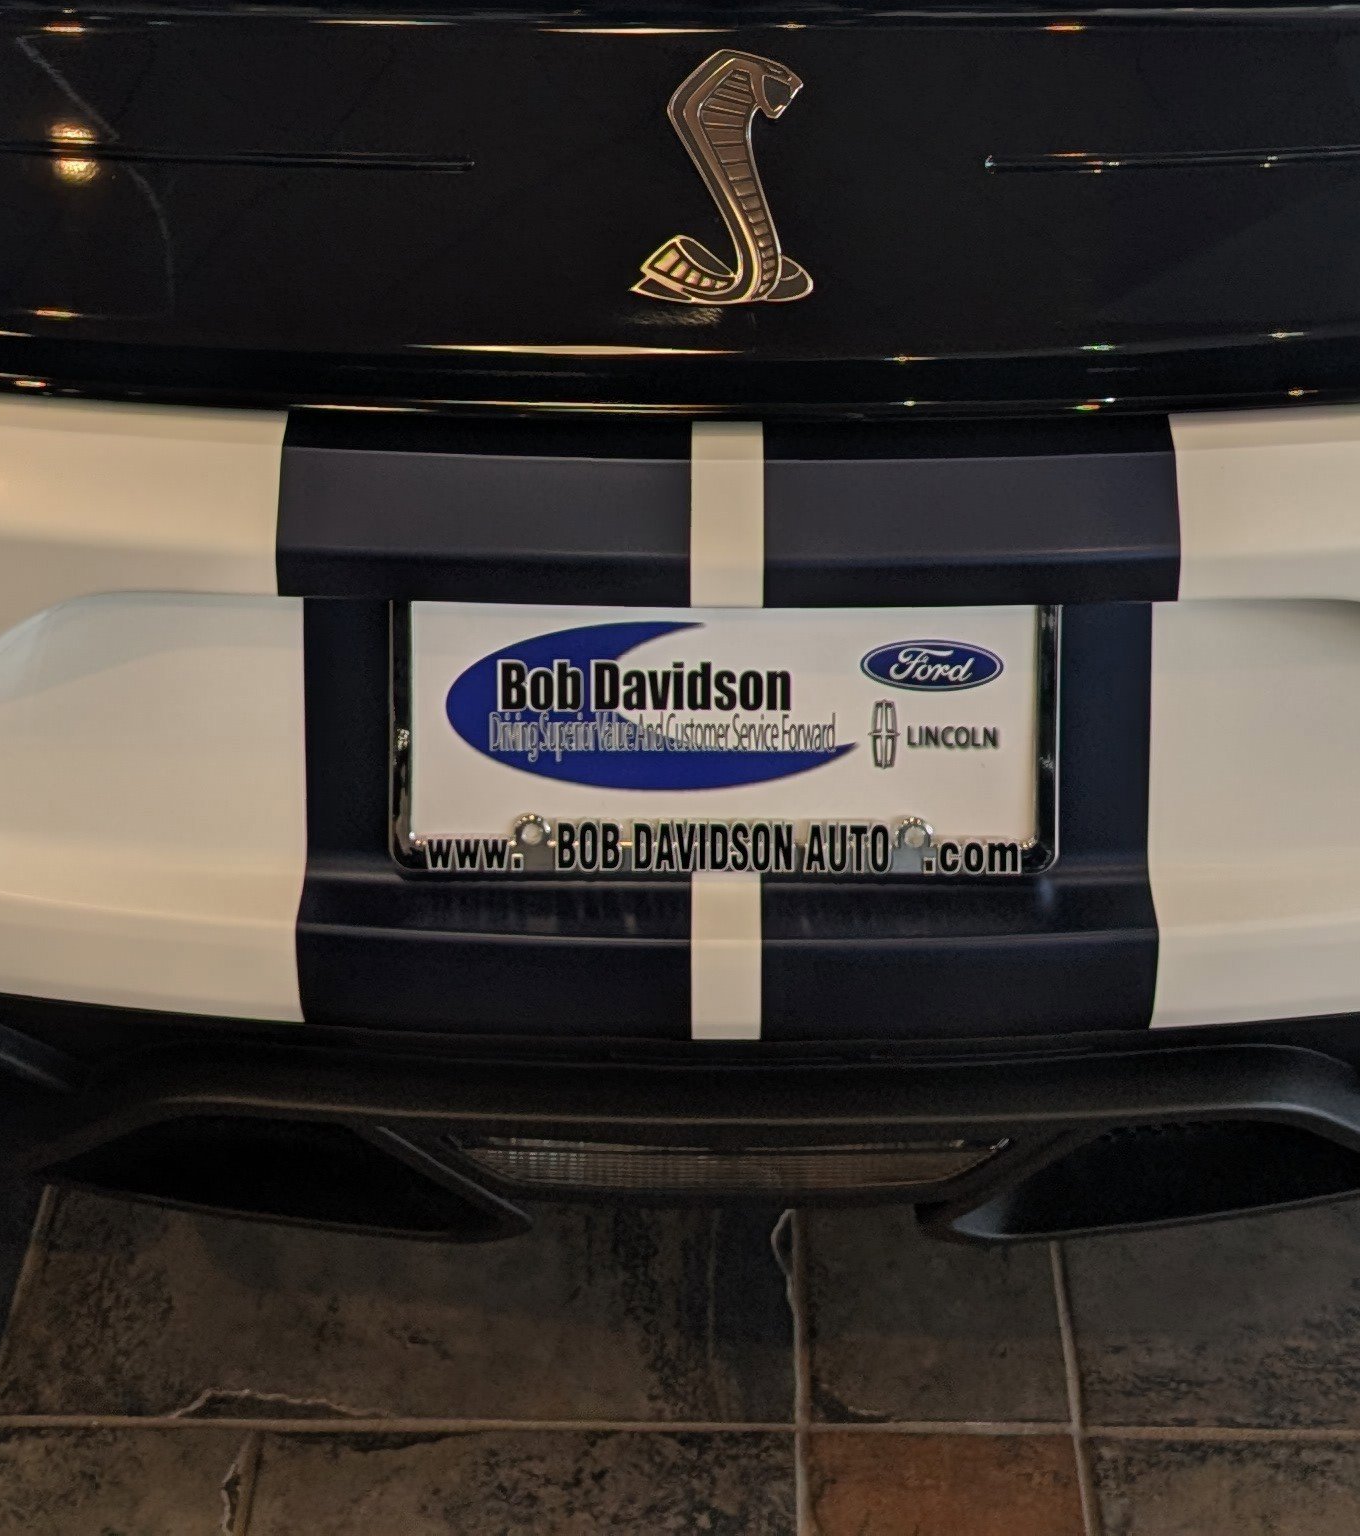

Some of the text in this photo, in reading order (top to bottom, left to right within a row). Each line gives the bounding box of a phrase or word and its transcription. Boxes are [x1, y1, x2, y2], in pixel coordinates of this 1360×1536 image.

[499, 660, 792, 712] Bob Davidson
[889, 647, 975, 682] Ford
[489, 712, 837, 763] Driving Superior Value And Customer Service Forward
[906, 725, 999, 748] LINCOLN
[425, 820, 1022, 874] www. BOB DAVIDSON AUTO .com
